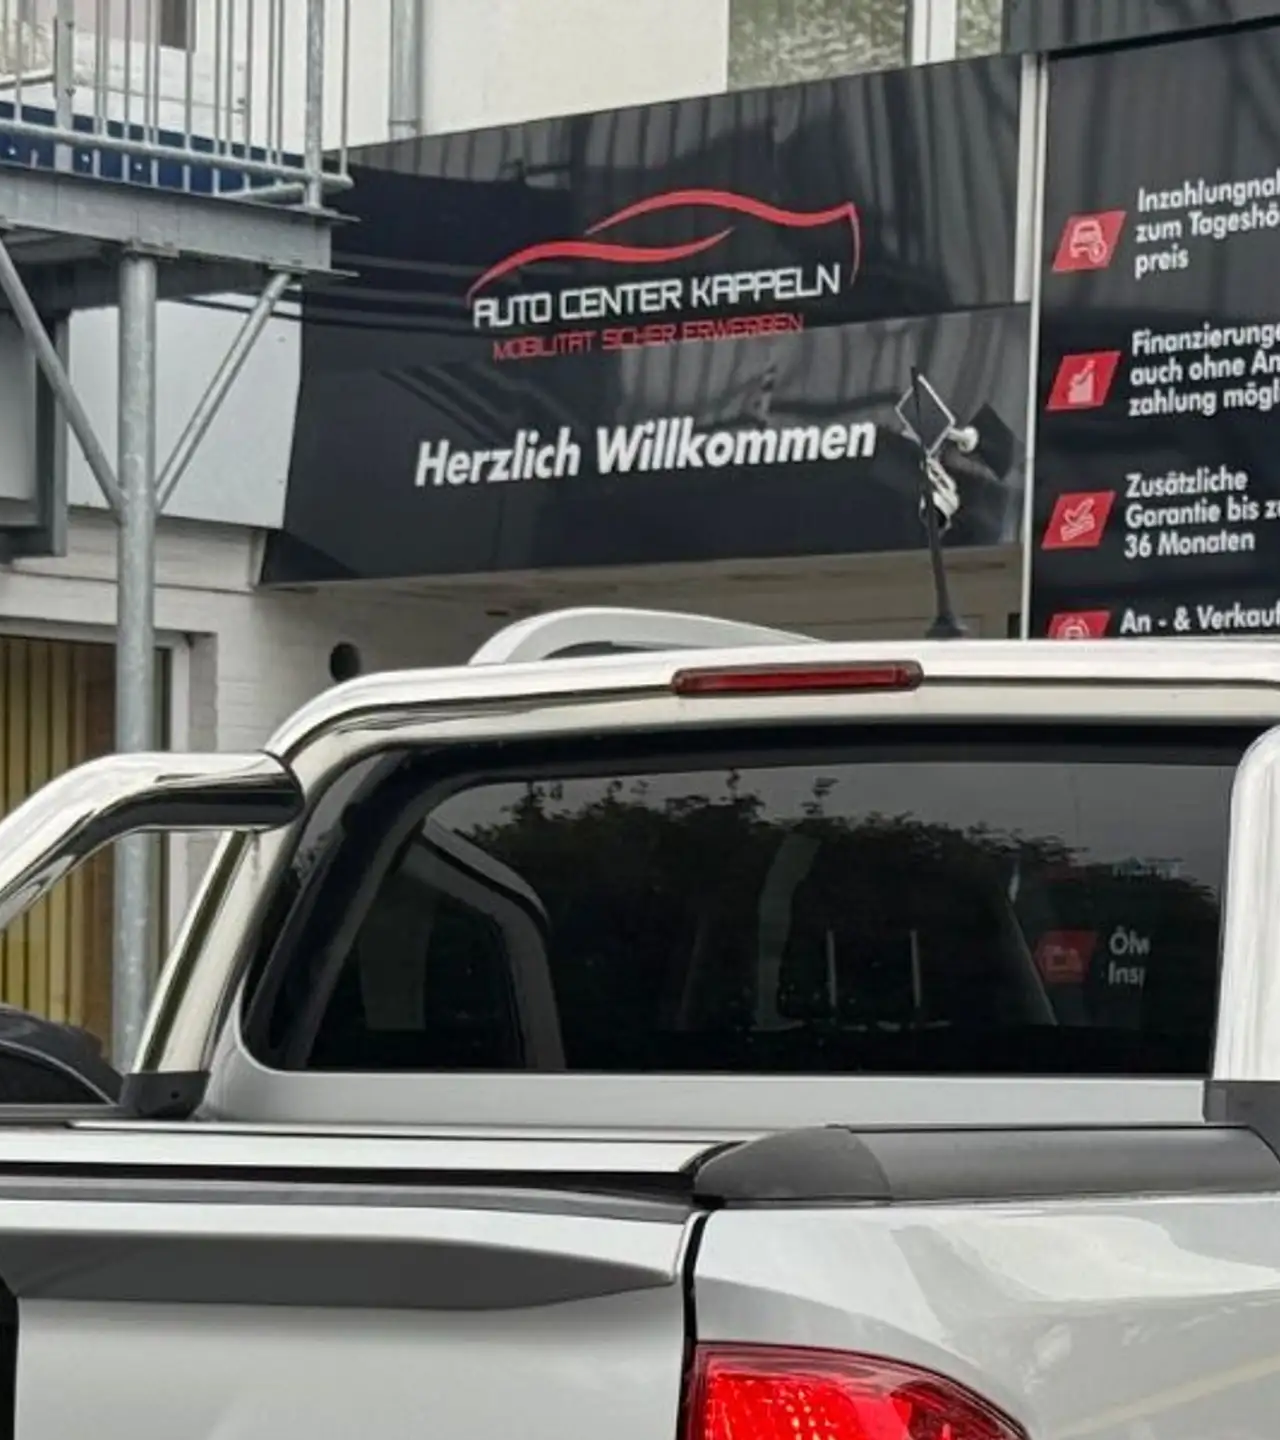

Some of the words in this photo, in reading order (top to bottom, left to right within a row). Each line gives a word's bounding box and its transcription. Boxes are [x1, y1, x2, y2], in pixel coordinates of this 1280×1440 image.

[1135, 218, 1182, 243] zum
[1134, 243, 1189, 280] preis
[473, 293, 552, 328] AUTO
[560, 279, 681, 319] CENTER
[690, 262, 841, 308] KAPPELN
[1129, 356, 1183, 386] auch
[1188, 353, 1246, 381] ohne
[1128, 386, 1217, 417] zahlung
[414, 426, 581, 487] Herzlich
[595, 416, 876, 475] Willkommen
[1125, 464, 1249, 499] Zusätzliche
[1125, 498, 1221, 529] Garantie
[1227, 496, 1260, 522] bis
[1124, 532, 1152, 559] 36
[1157, 529, 1255, 556] Monaten
[1120, 608, 1152, 634] An
[1173, 606, 1190, 631] &
